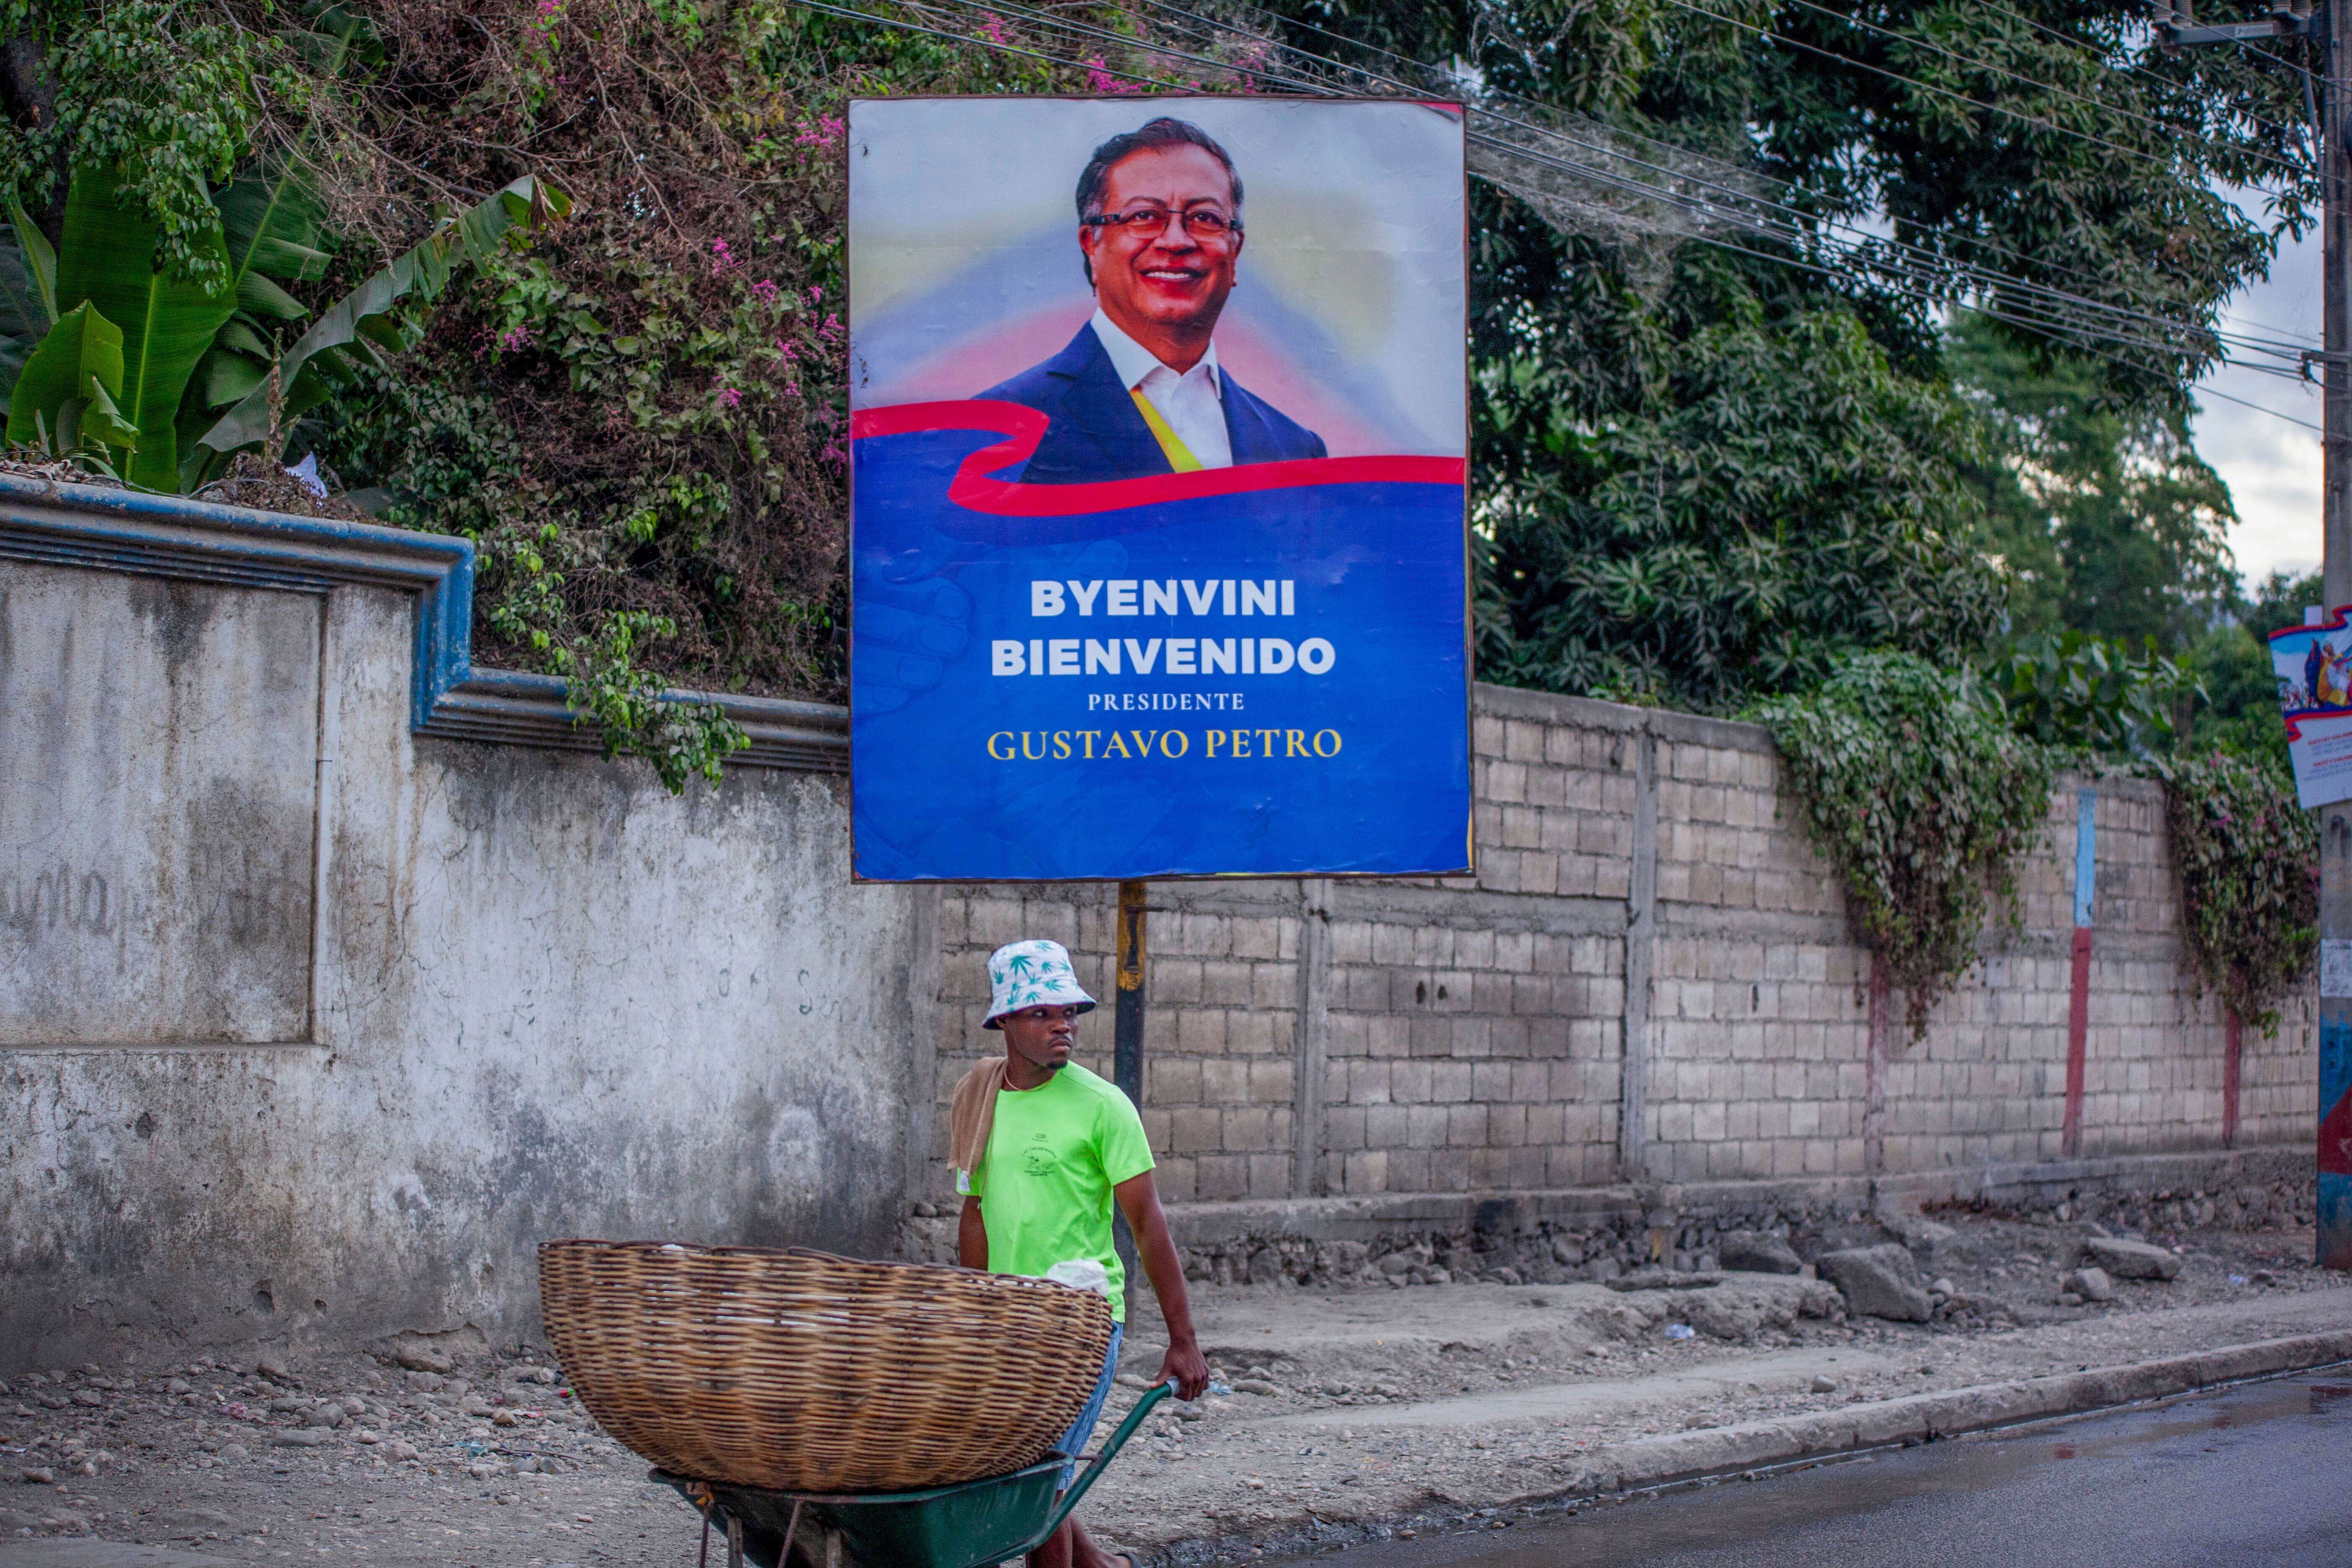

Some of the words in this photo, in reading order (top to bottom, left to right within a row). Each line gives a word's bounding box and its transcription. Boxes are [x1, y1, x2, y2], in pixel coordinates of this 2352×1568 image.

[1031, 580, 1295, 616] BYENVINI
[991, 637, 1336, 676] BIENVENIDO
[1088, 693, 1244, 711] PRESIDENTE
[987, 730, 1189, 760] GUSTAVO
[1206, 729, 1342, 758] PETRO
